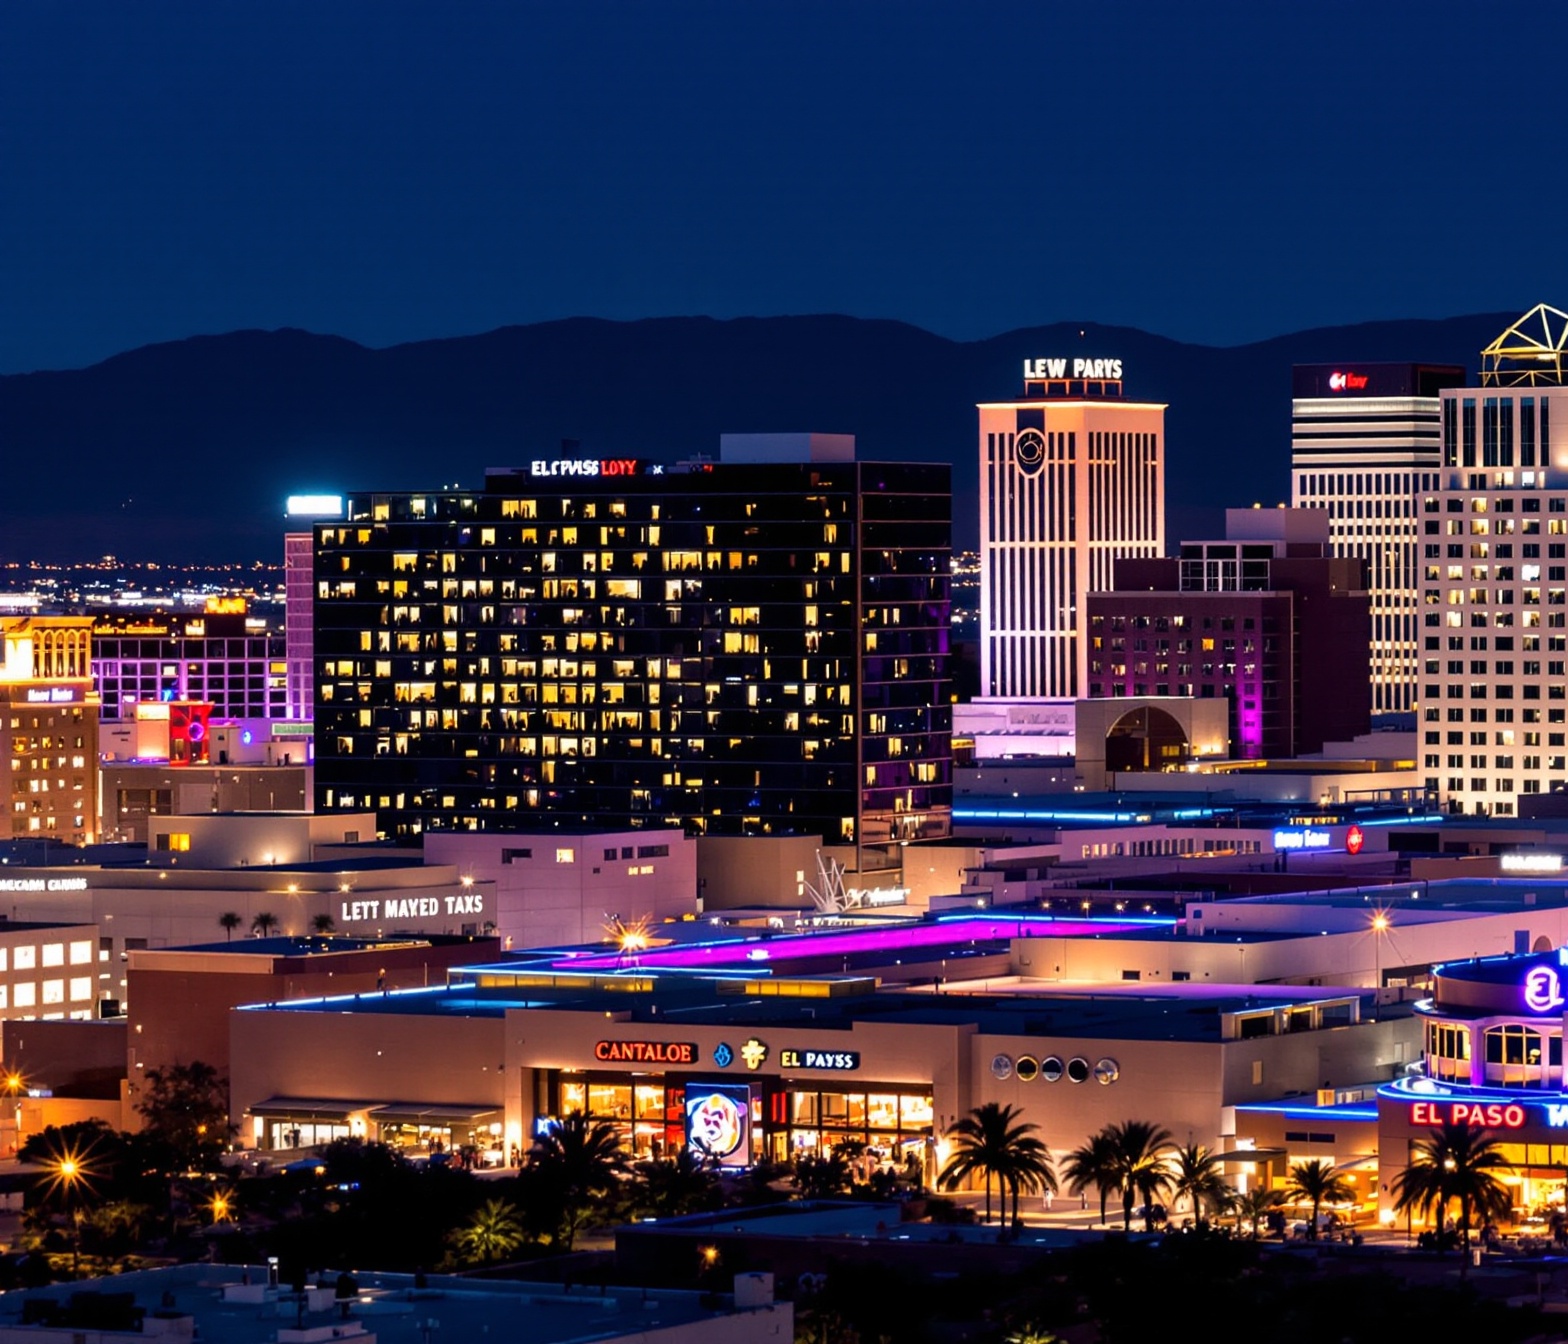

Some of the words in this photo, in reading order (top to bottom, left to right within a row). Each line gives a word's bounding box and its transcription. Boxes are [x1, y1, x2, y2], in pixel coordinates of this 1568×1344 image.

[1025, 359, 1066, 378] LEW
[1074, 359, 1122, 378] PARYS
[445, 895, 482, 914] TAXS
[596, 1042, 692, 1062] CANTALOE
[782, 1052, 801, 1067] EL
[1412, 1102, 1443, 1124] EL
[1452, 1104, 1525, 1127] PASO
